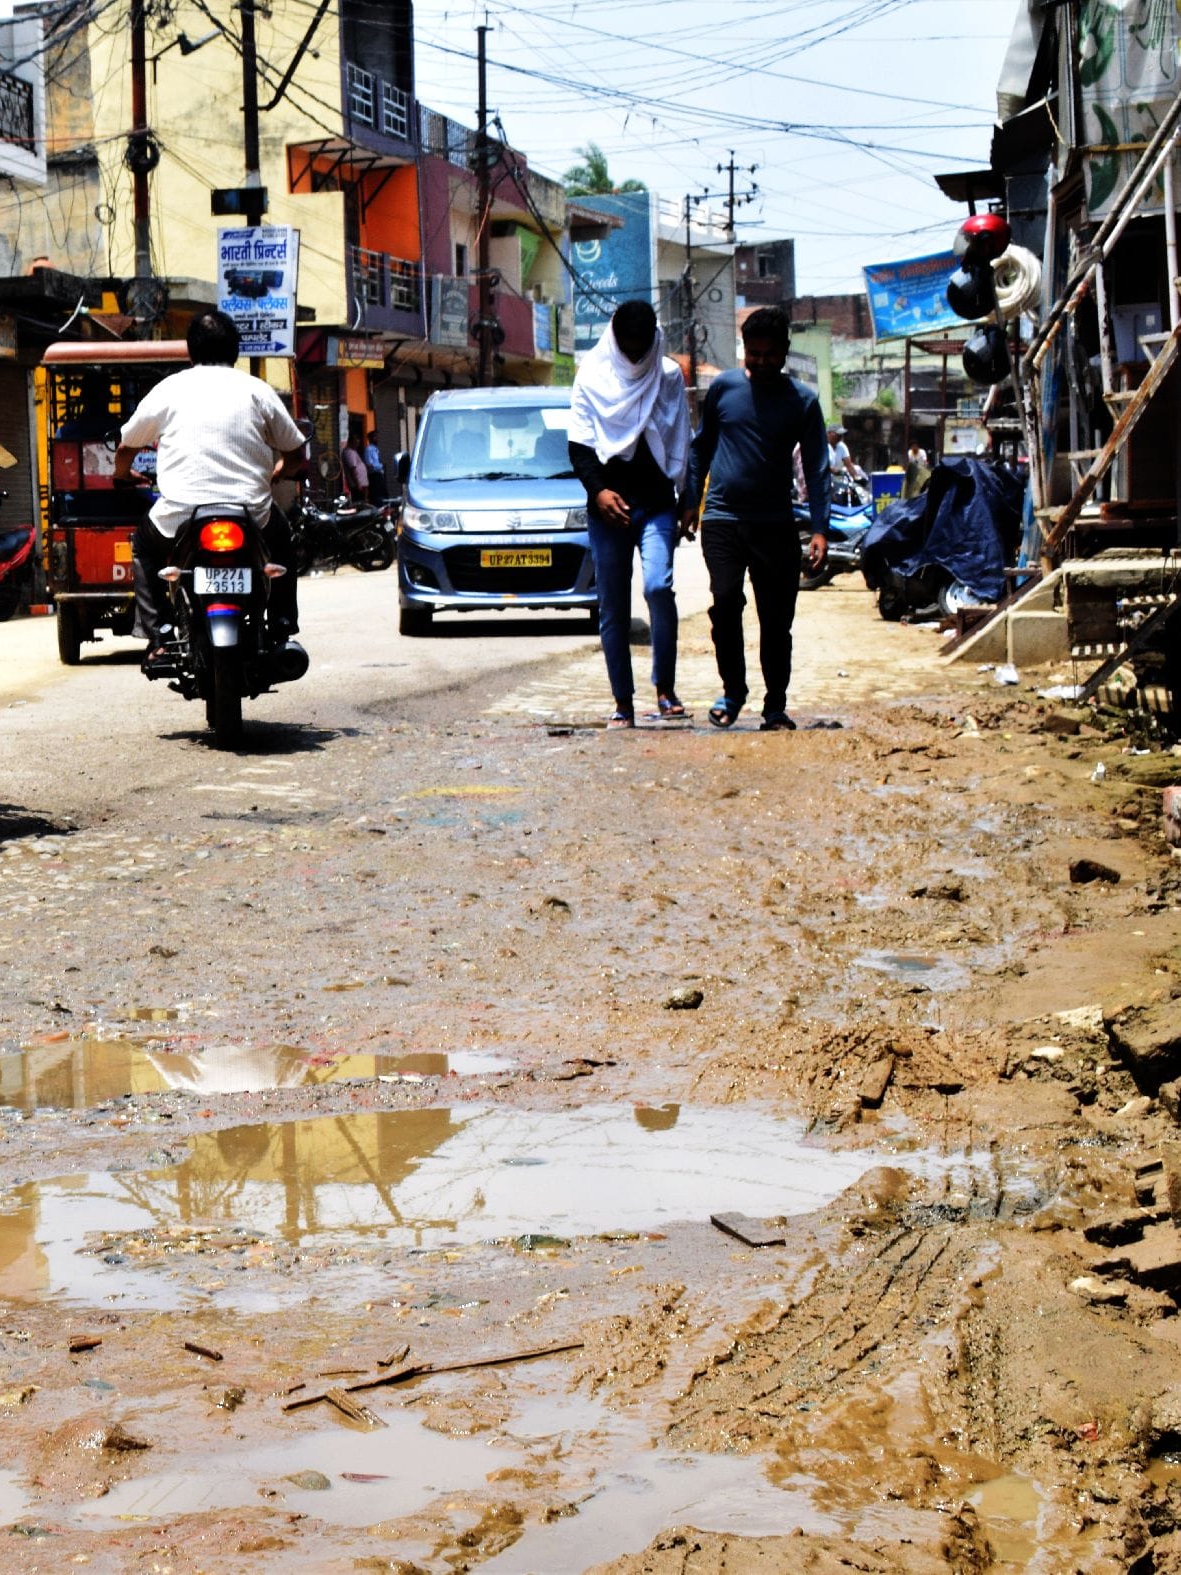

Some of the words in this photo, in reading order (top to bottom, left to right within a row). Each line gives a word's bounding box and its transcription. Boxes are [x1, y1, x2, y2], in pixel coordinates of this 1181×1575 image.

[221, 240, 251, 261] भारती
[206, 568, 244, 580] UP27A
[205, 581, 244, 593] Z3513
